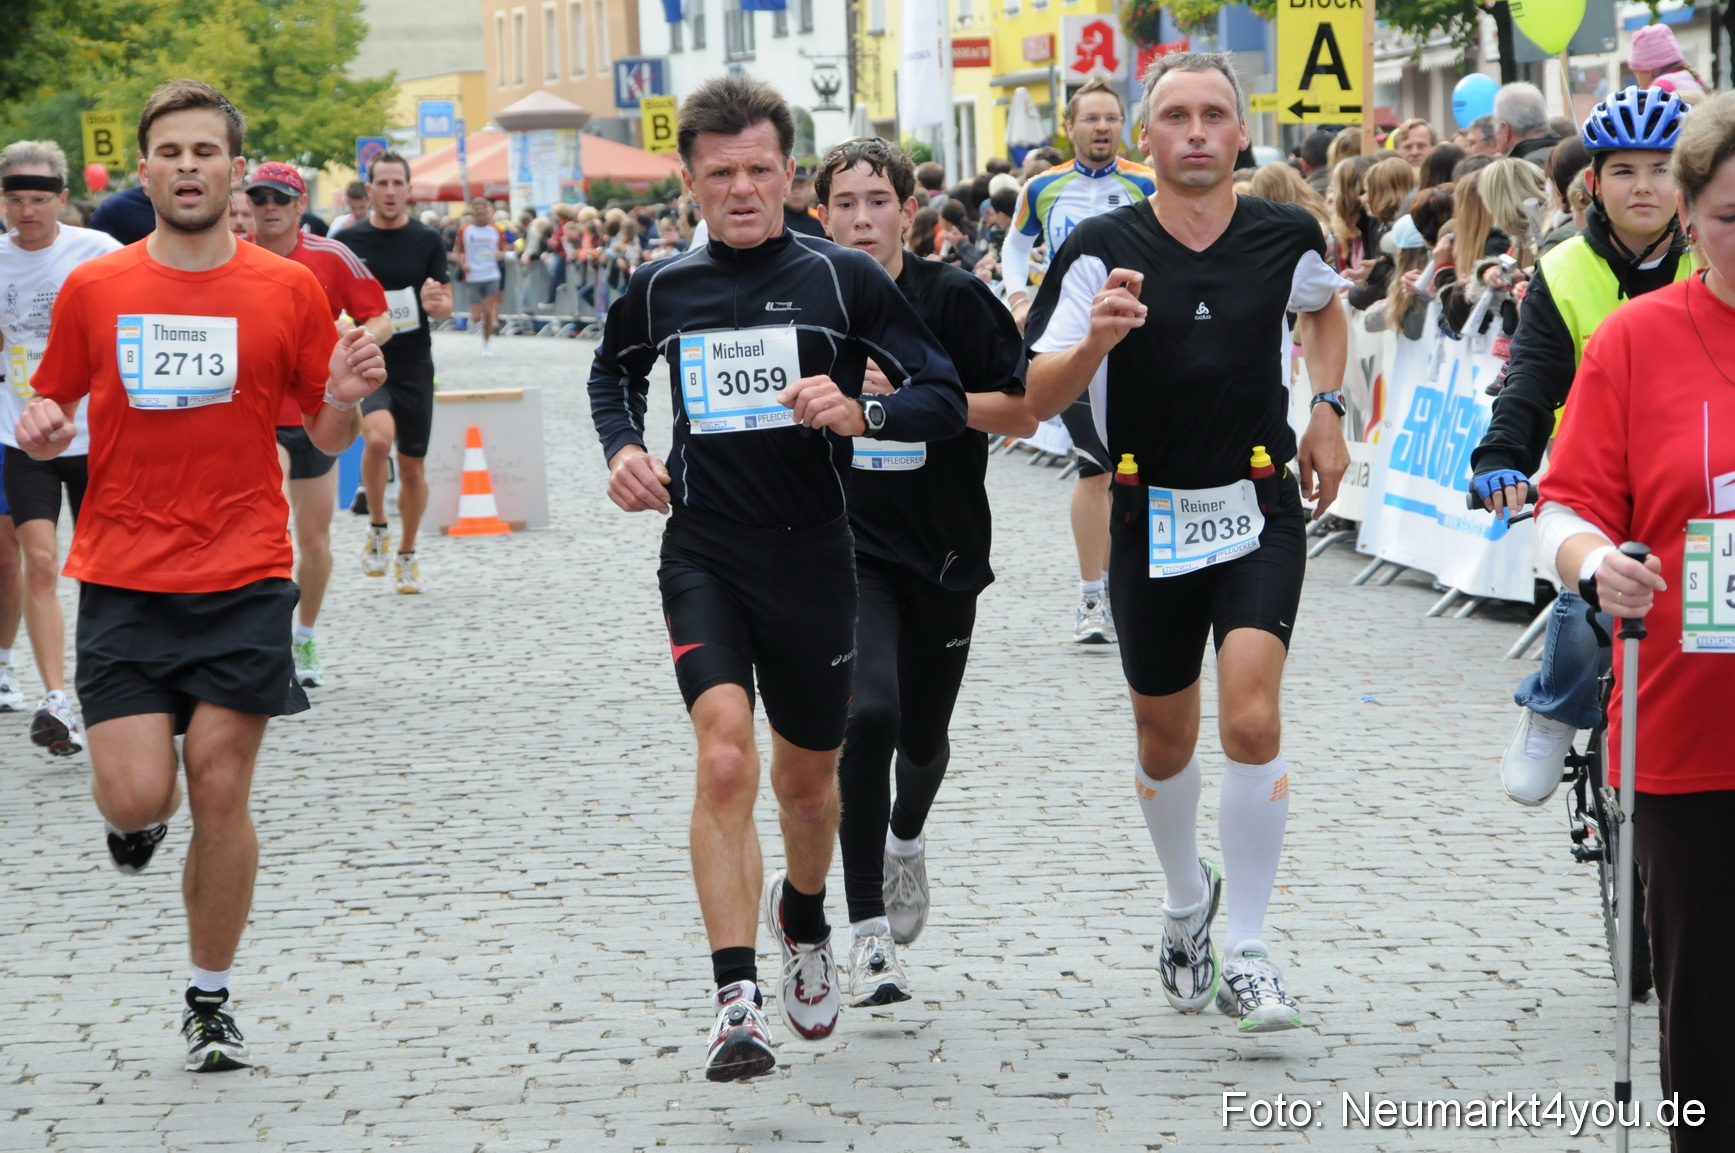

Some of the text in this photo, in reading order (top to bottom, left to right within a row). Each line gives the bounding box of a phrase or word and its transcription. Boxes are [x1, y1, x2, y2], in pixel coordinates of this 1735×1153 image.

[1297, 21, 1353, 91] A
[653, 113, 671, 140] B
[94, 129, 114, 156] B
[152, 323, 207, 342] Thomas
[127, 350, 134, 363] B
[712, 338, 764, 360] Michael
[154, 352, 225, 376] 2713
[690, 372, 697, 386] B
[716, 366, 787, 396] 3059
[884, 456, 924, 465] PFLEIDERER
[1180, 498, 1226, 513] Reiner
[1157, 521, 1165, 533] A
[1184, 515, 1251, 545] 2038
[1689, 572, 1697, 590] S
